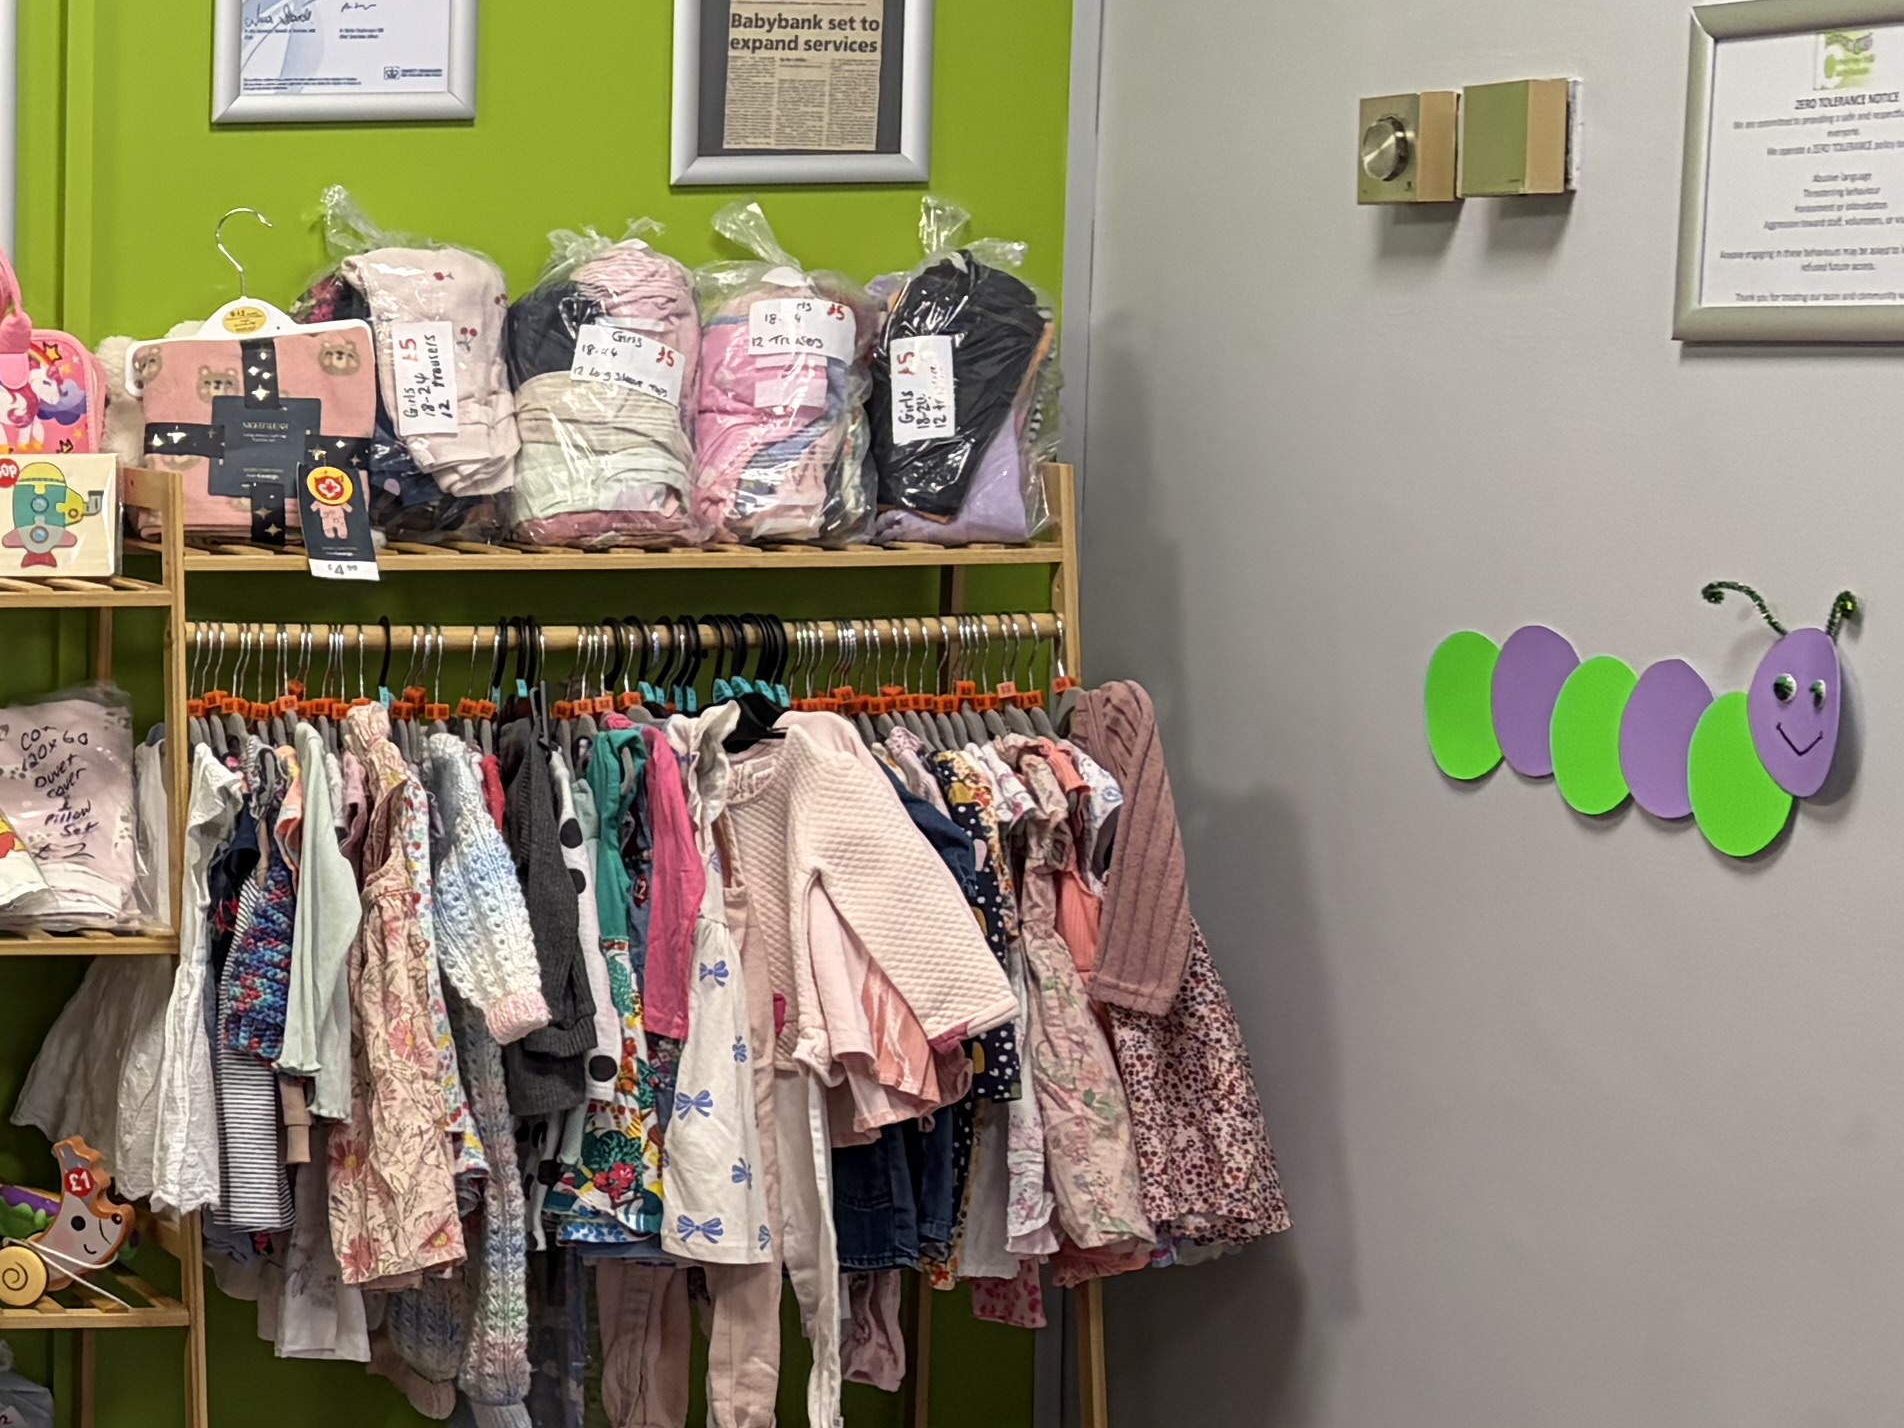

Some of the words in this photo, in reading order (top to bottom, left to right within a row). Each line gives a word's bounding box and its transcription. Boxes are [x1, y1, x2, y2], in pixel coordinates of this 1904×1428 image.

[730, 12, 823, 33] Babybank
[828, 15, 856, 31] set
[860, 15, 880, 31] to
[730, 35, 799, 54] expand
[803, 37, 878, 53] services
[404, 388, 418, 418] Girls
[68, 1172, 92, 1192] £1
